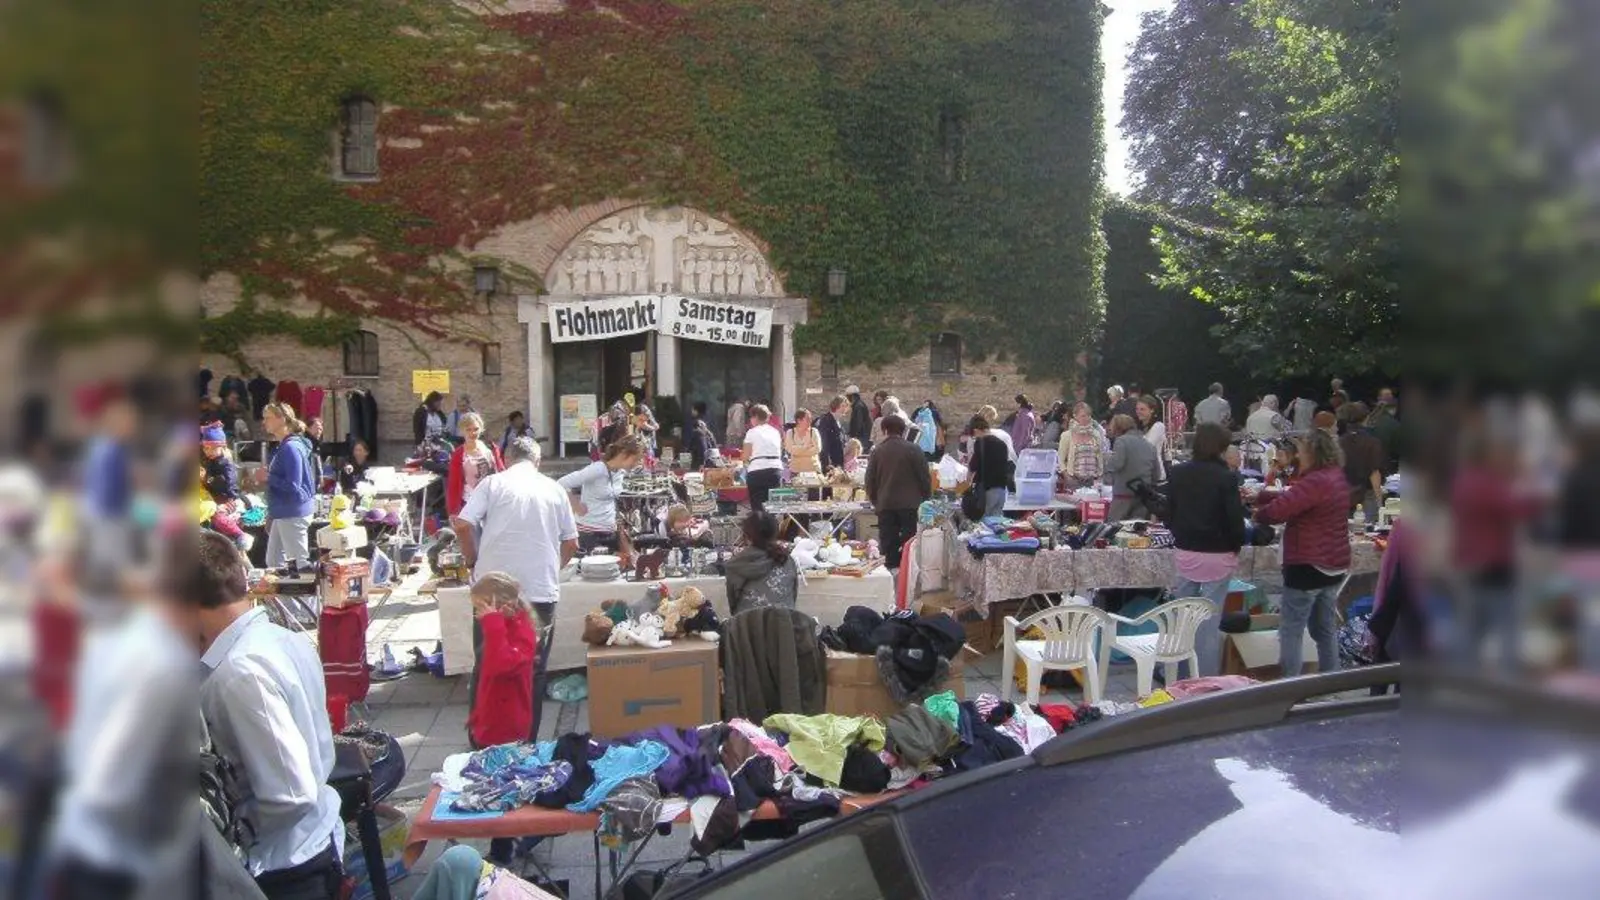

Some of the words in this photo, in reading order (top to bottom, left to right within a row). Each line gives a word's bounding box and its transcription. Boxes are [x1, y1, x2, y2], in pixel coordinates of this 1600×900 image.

[555, 299, 657, 337] Flohmarkt
[678, 298, 756, 329] Samstag
[706, 326, 738, 342] 15.00
[741, 331, 765, 346] Uhr
